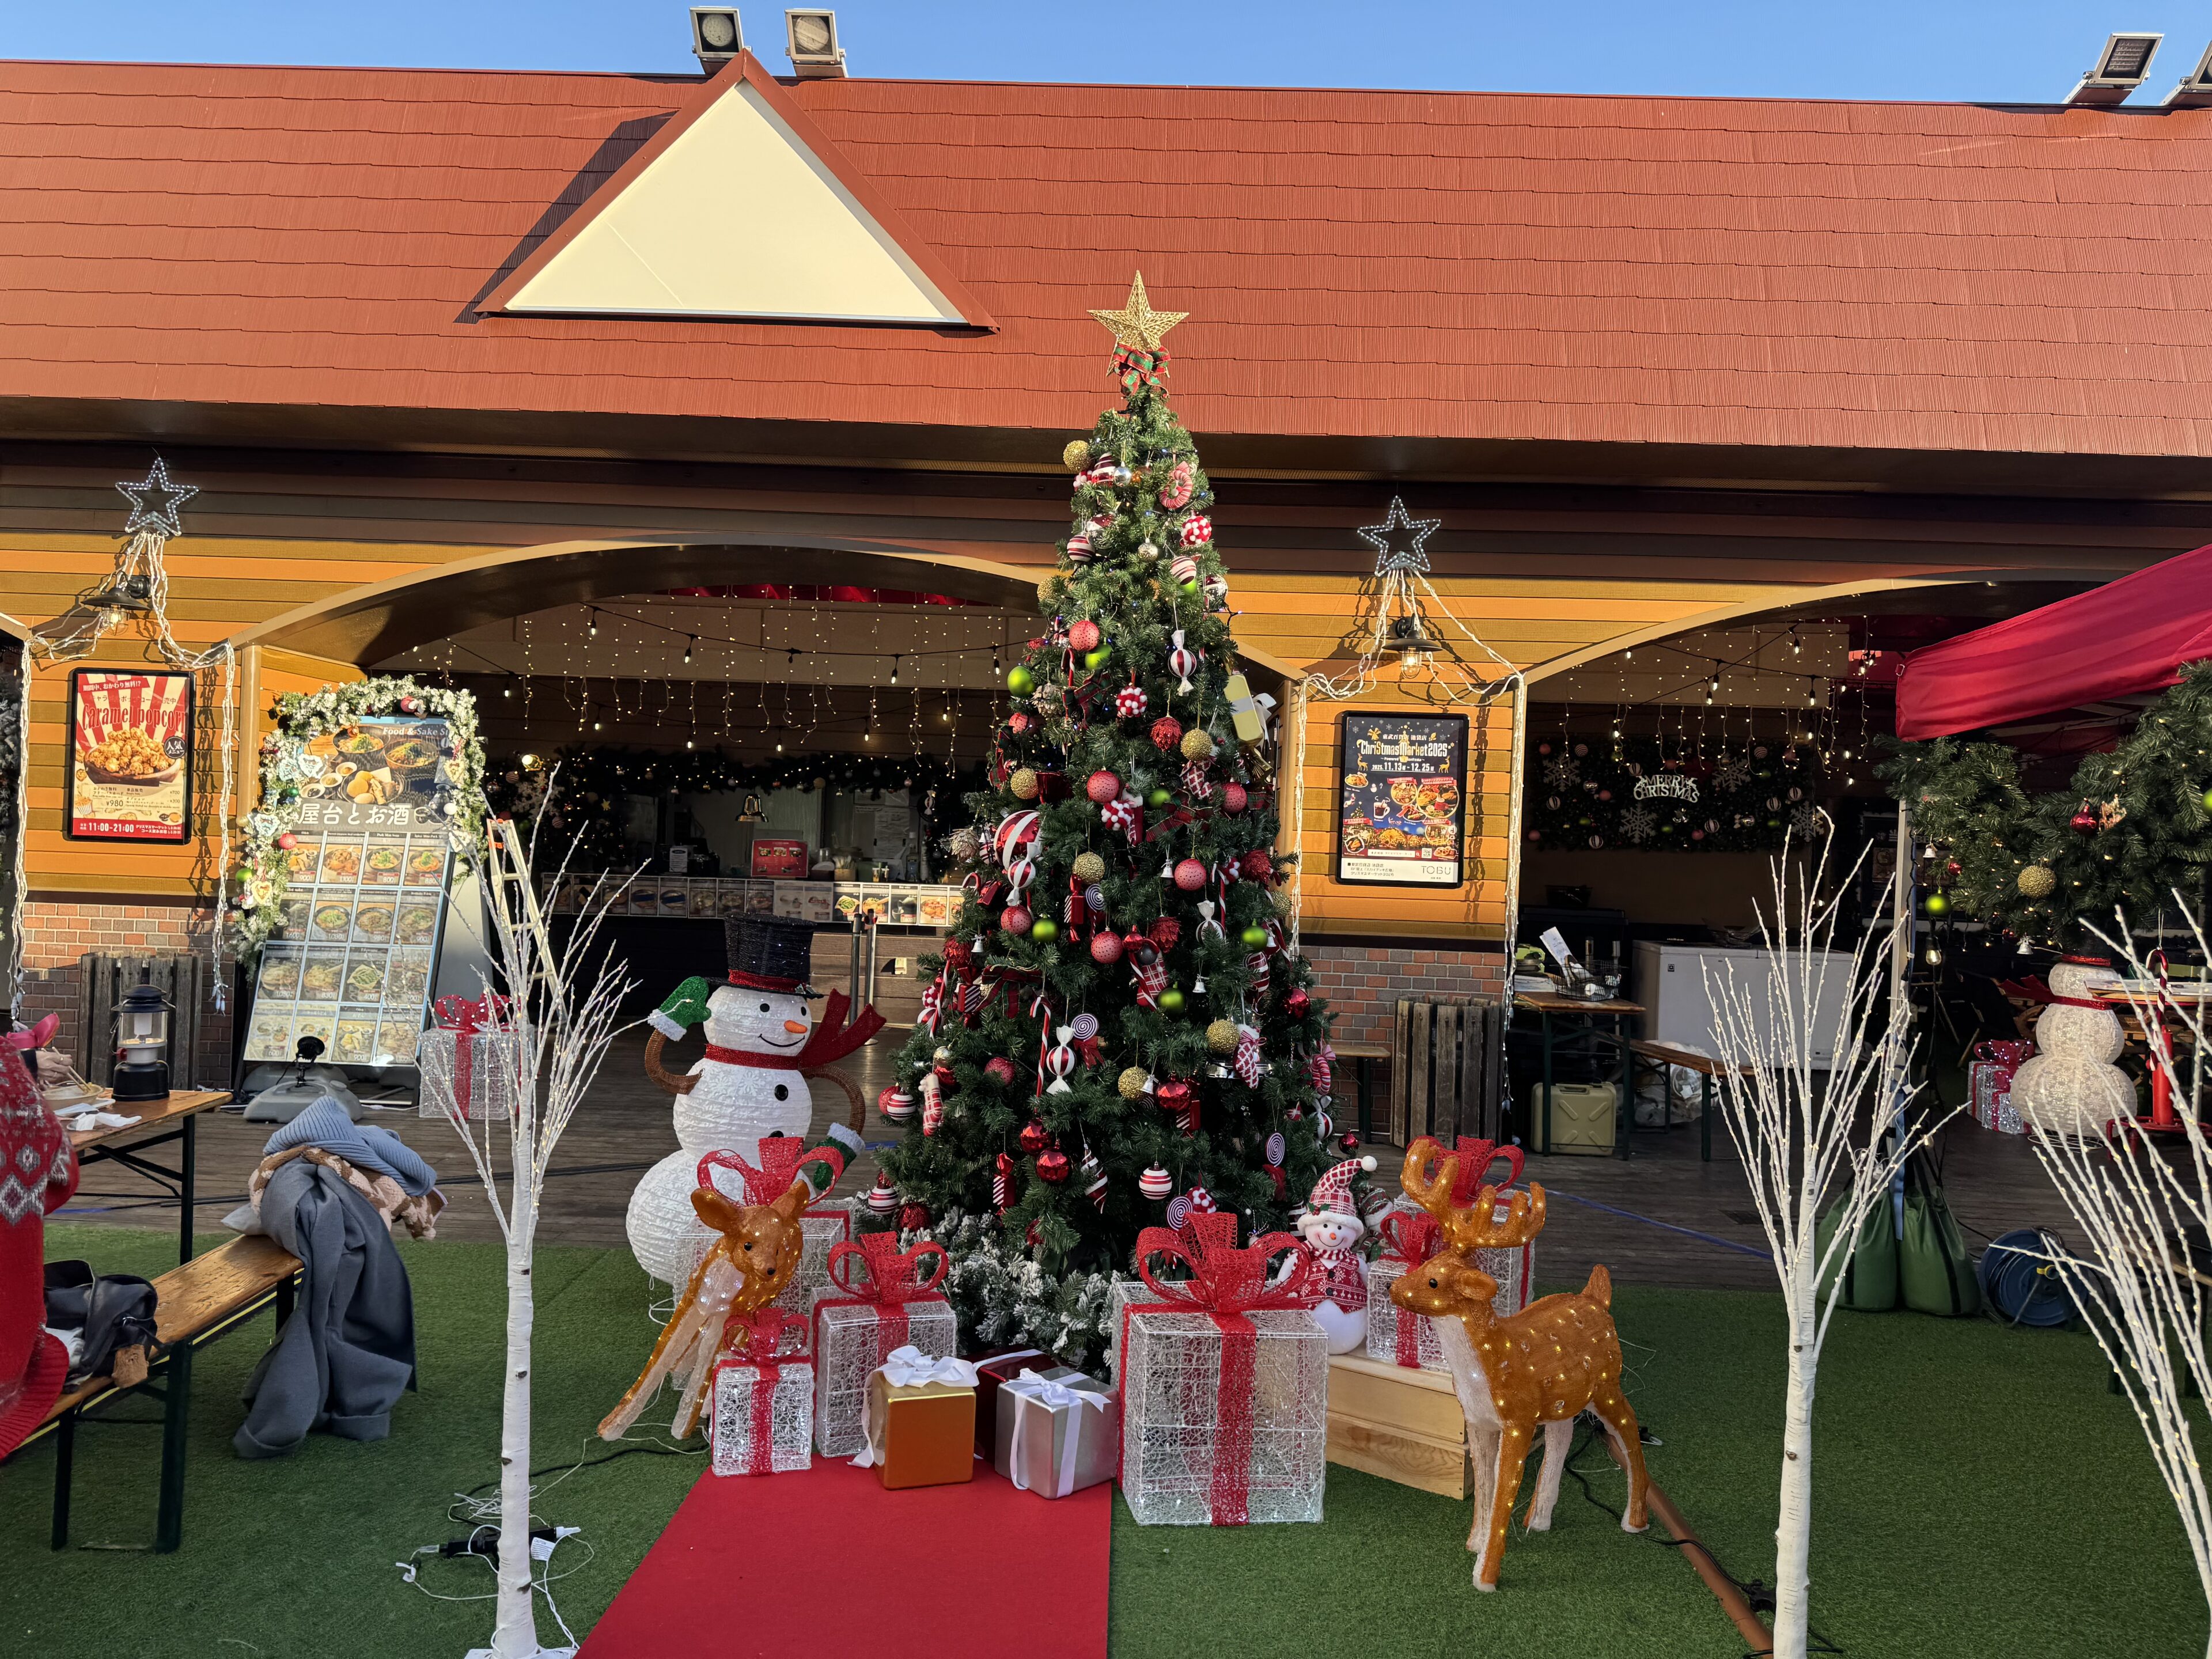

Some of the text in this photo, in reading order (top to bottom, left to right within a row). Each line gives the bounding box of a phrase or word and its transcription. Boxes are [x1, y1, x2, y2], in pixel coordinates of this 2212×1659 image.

[82, 703, 187, 733] Caramel popcorn
[382, 727, 405, 735] Food
[407, 727, 415, 735] &
[416, 728, 438, 736] Sake
[1633, 785, 1700, 803] CHRISTMAS
[298, 802, 412, 825] 屋台とお酒
[88, 822, 134, 832] 11:00-21:00
[1421, 865, 1451, 875] TOBU
